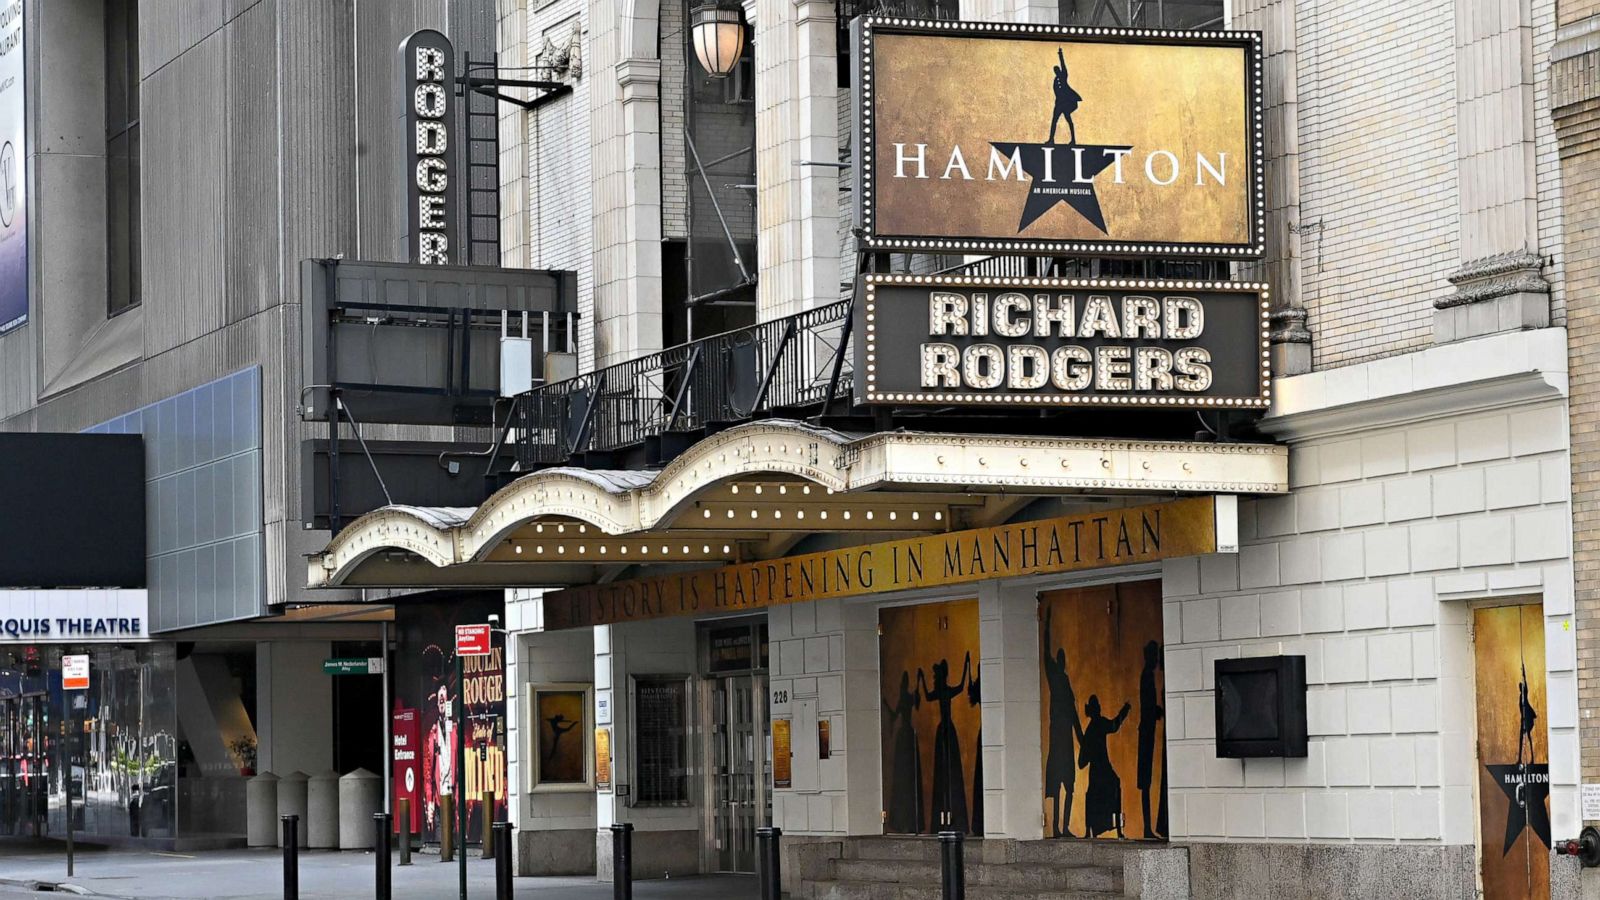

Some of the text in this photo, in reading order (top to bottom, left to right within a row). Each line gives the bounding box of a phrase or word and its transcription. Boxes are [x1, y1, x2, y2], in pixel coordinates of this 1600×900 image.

[892, 142, 1230, 186] HAMILTON
[1042, 187, 1069, 195] AMERICAN
[1069, 188, 1092, 196] MUSICAL
[929, 291, 1204, 339] RICHARD
[920, 343, 1213, 392] RODGERS
[570, 509, 1161, 624] HISTORY IS HAPPENING IN MANHATTAN
[0, 618, 140, 637] QUIS THEATRE
[465, 627, 485, 635] STANDING
[458, 635, 476, 643] Anytime
[463, 647, 502, 673] MOULIN
[463, 675, 503, 705] ROUGE
[394, 734, 407, 746] Hotel
[394, 748, 415, 760] Entrance
[464, 746, 504, 801] MIND
[1504, 773, 1549, 784] HAMILTON
